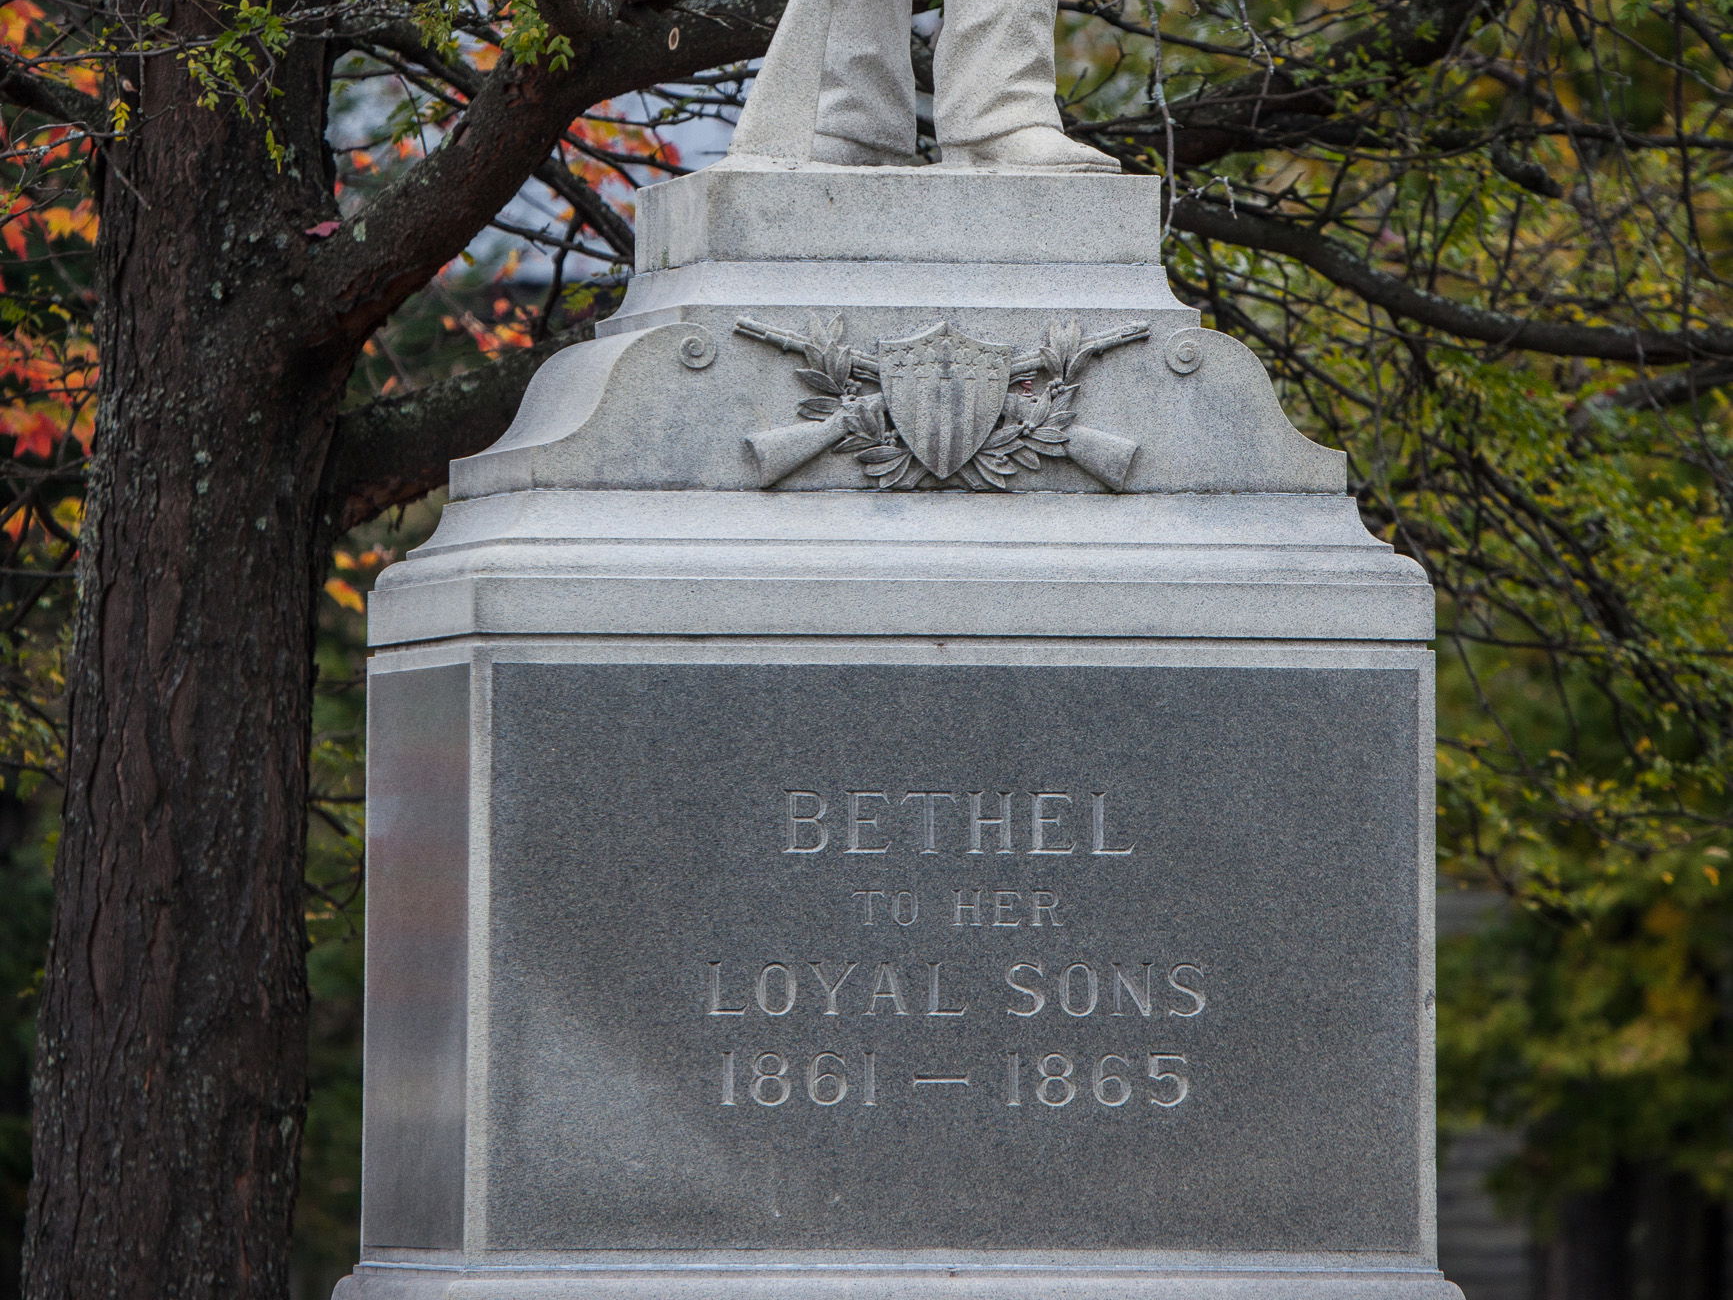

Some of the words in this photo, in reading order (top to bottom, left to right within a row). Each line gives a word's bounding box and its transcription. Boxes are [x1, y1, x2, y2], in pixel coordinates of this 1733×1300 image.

[783, 789, 1135, 855] BETHEL
[852, 889, 919, 927] TO
[951, 889, 1064, 927] HER
[706, 961, 967, 1017] LOYAL
[1005, 961, 1207, 1017] SONS
[720, 1051, 877, 1107] 1861
[1006, 1051, 1189, 1108] 1865
